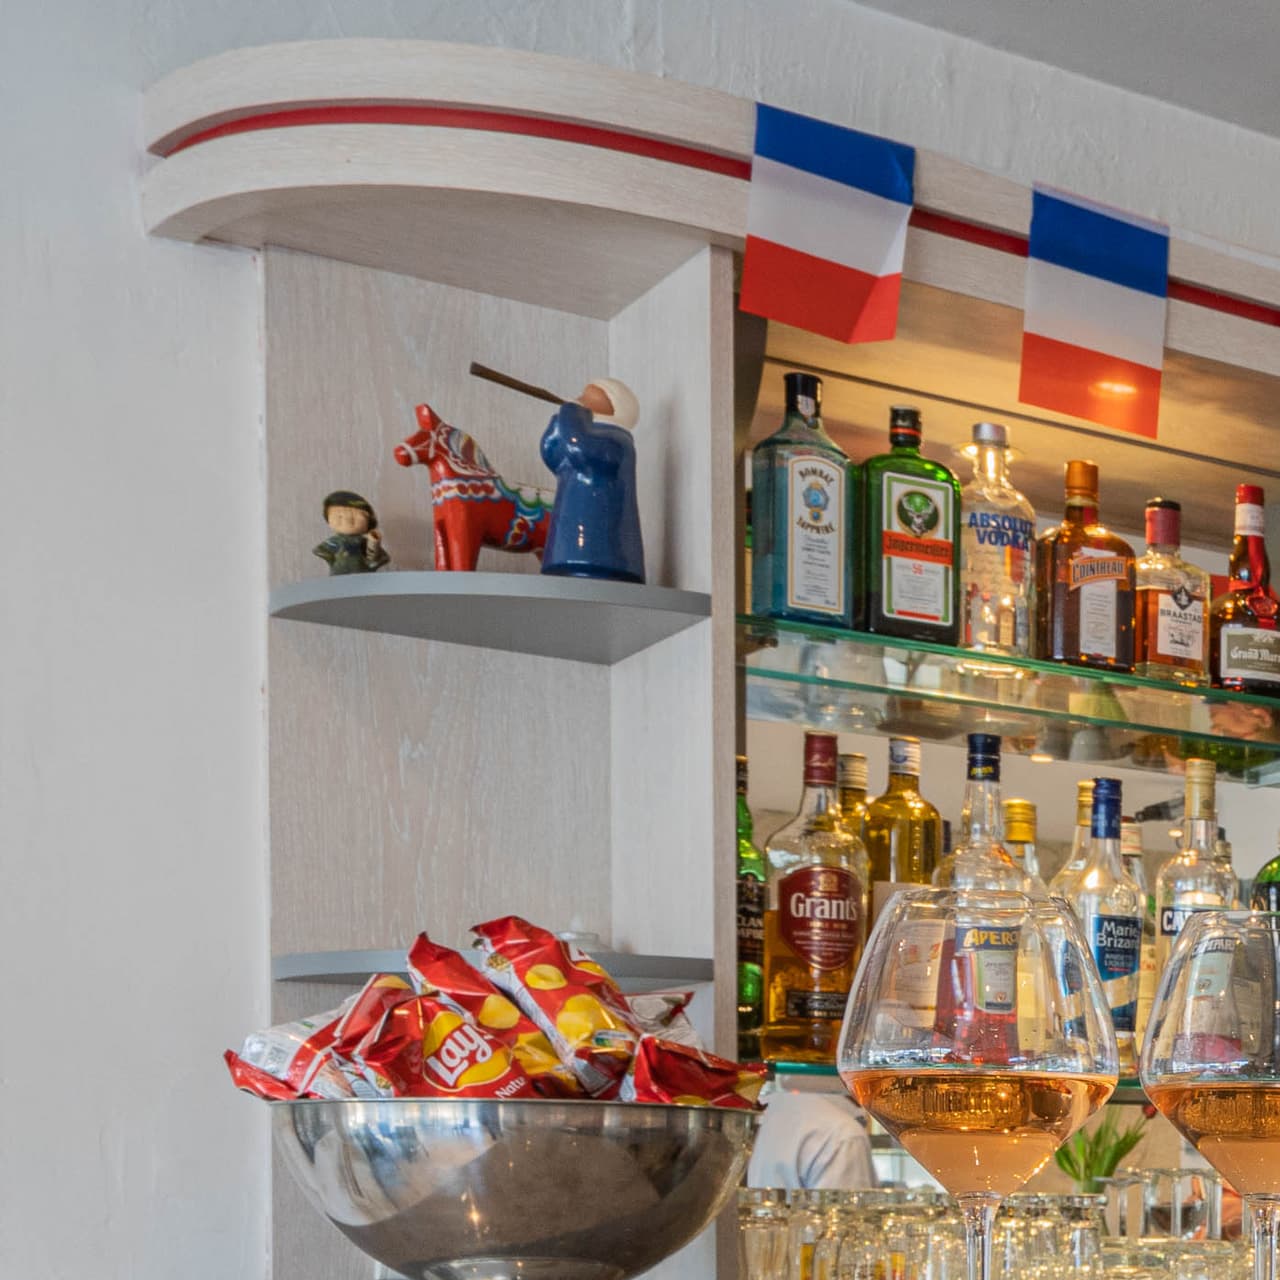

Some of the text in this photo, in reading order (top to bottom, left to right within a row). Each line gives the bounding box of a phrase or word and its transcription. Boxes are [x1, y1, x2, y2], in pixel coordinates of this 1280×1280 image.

[798, 466, 835, 486] BOMBAY
[969, 512, 1033, 537] ABSOLUT
[976, 529, 1029, 552] VODKA
[964, 928, 1018, 947] APERO
[1102, 920, 1138, 937] Marie
[1097, 933, 1139, 949] Brizar
[495, 1076, 526, 1099] Natu
